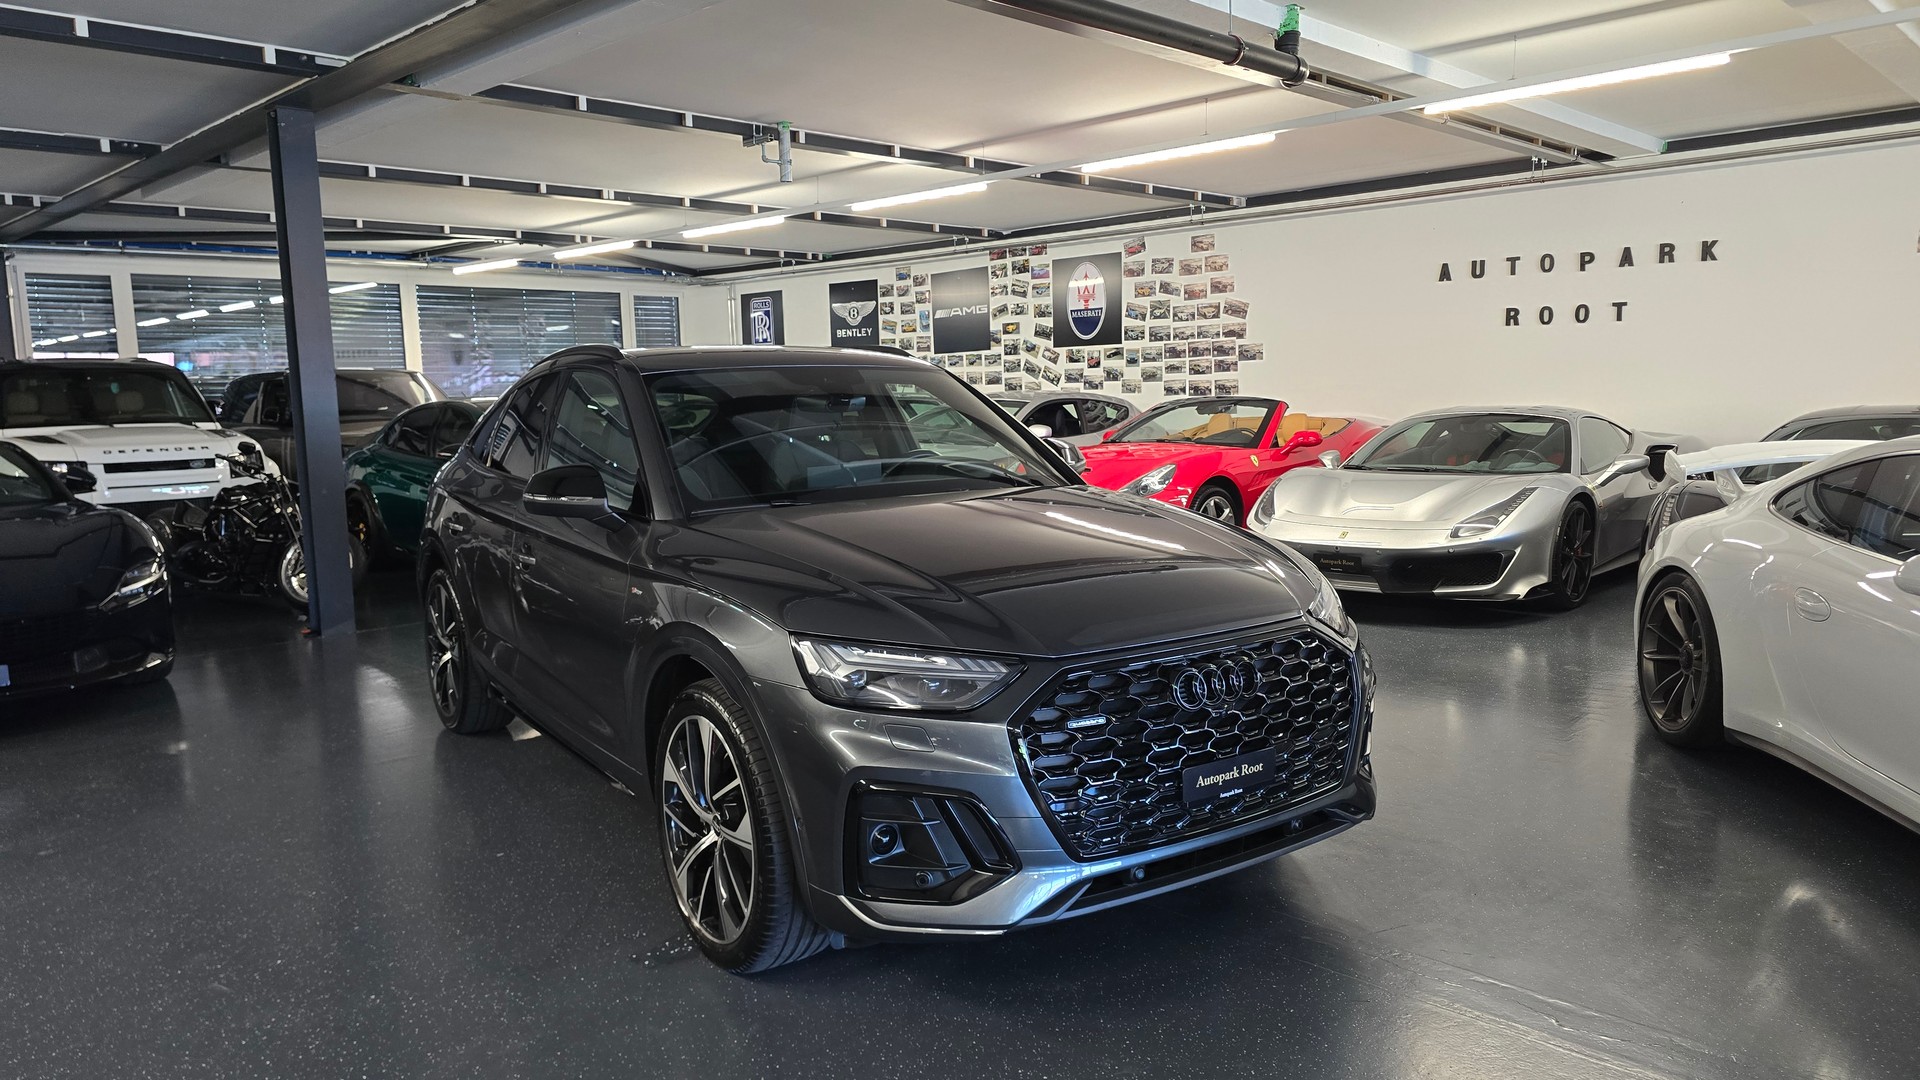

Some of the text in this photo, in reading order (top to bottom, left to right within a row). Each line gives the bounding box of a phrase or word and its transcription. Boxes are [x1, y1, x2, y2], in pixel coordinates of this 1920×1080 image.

[1438, 240, 1719, 282] AUTOPARK
[753, 301, 770, 309] ROLLS
[950, 304, 988, 317] AMG
[1071, 309, 1102, 318] MASERATI
[1505, 301, 1628, 327] ROOT
[836, 328, 872, 338] BENTLEY
[103, 446, 209, 455] DEFENDER
[1196, 763, 1263, 788] Autopark Root
